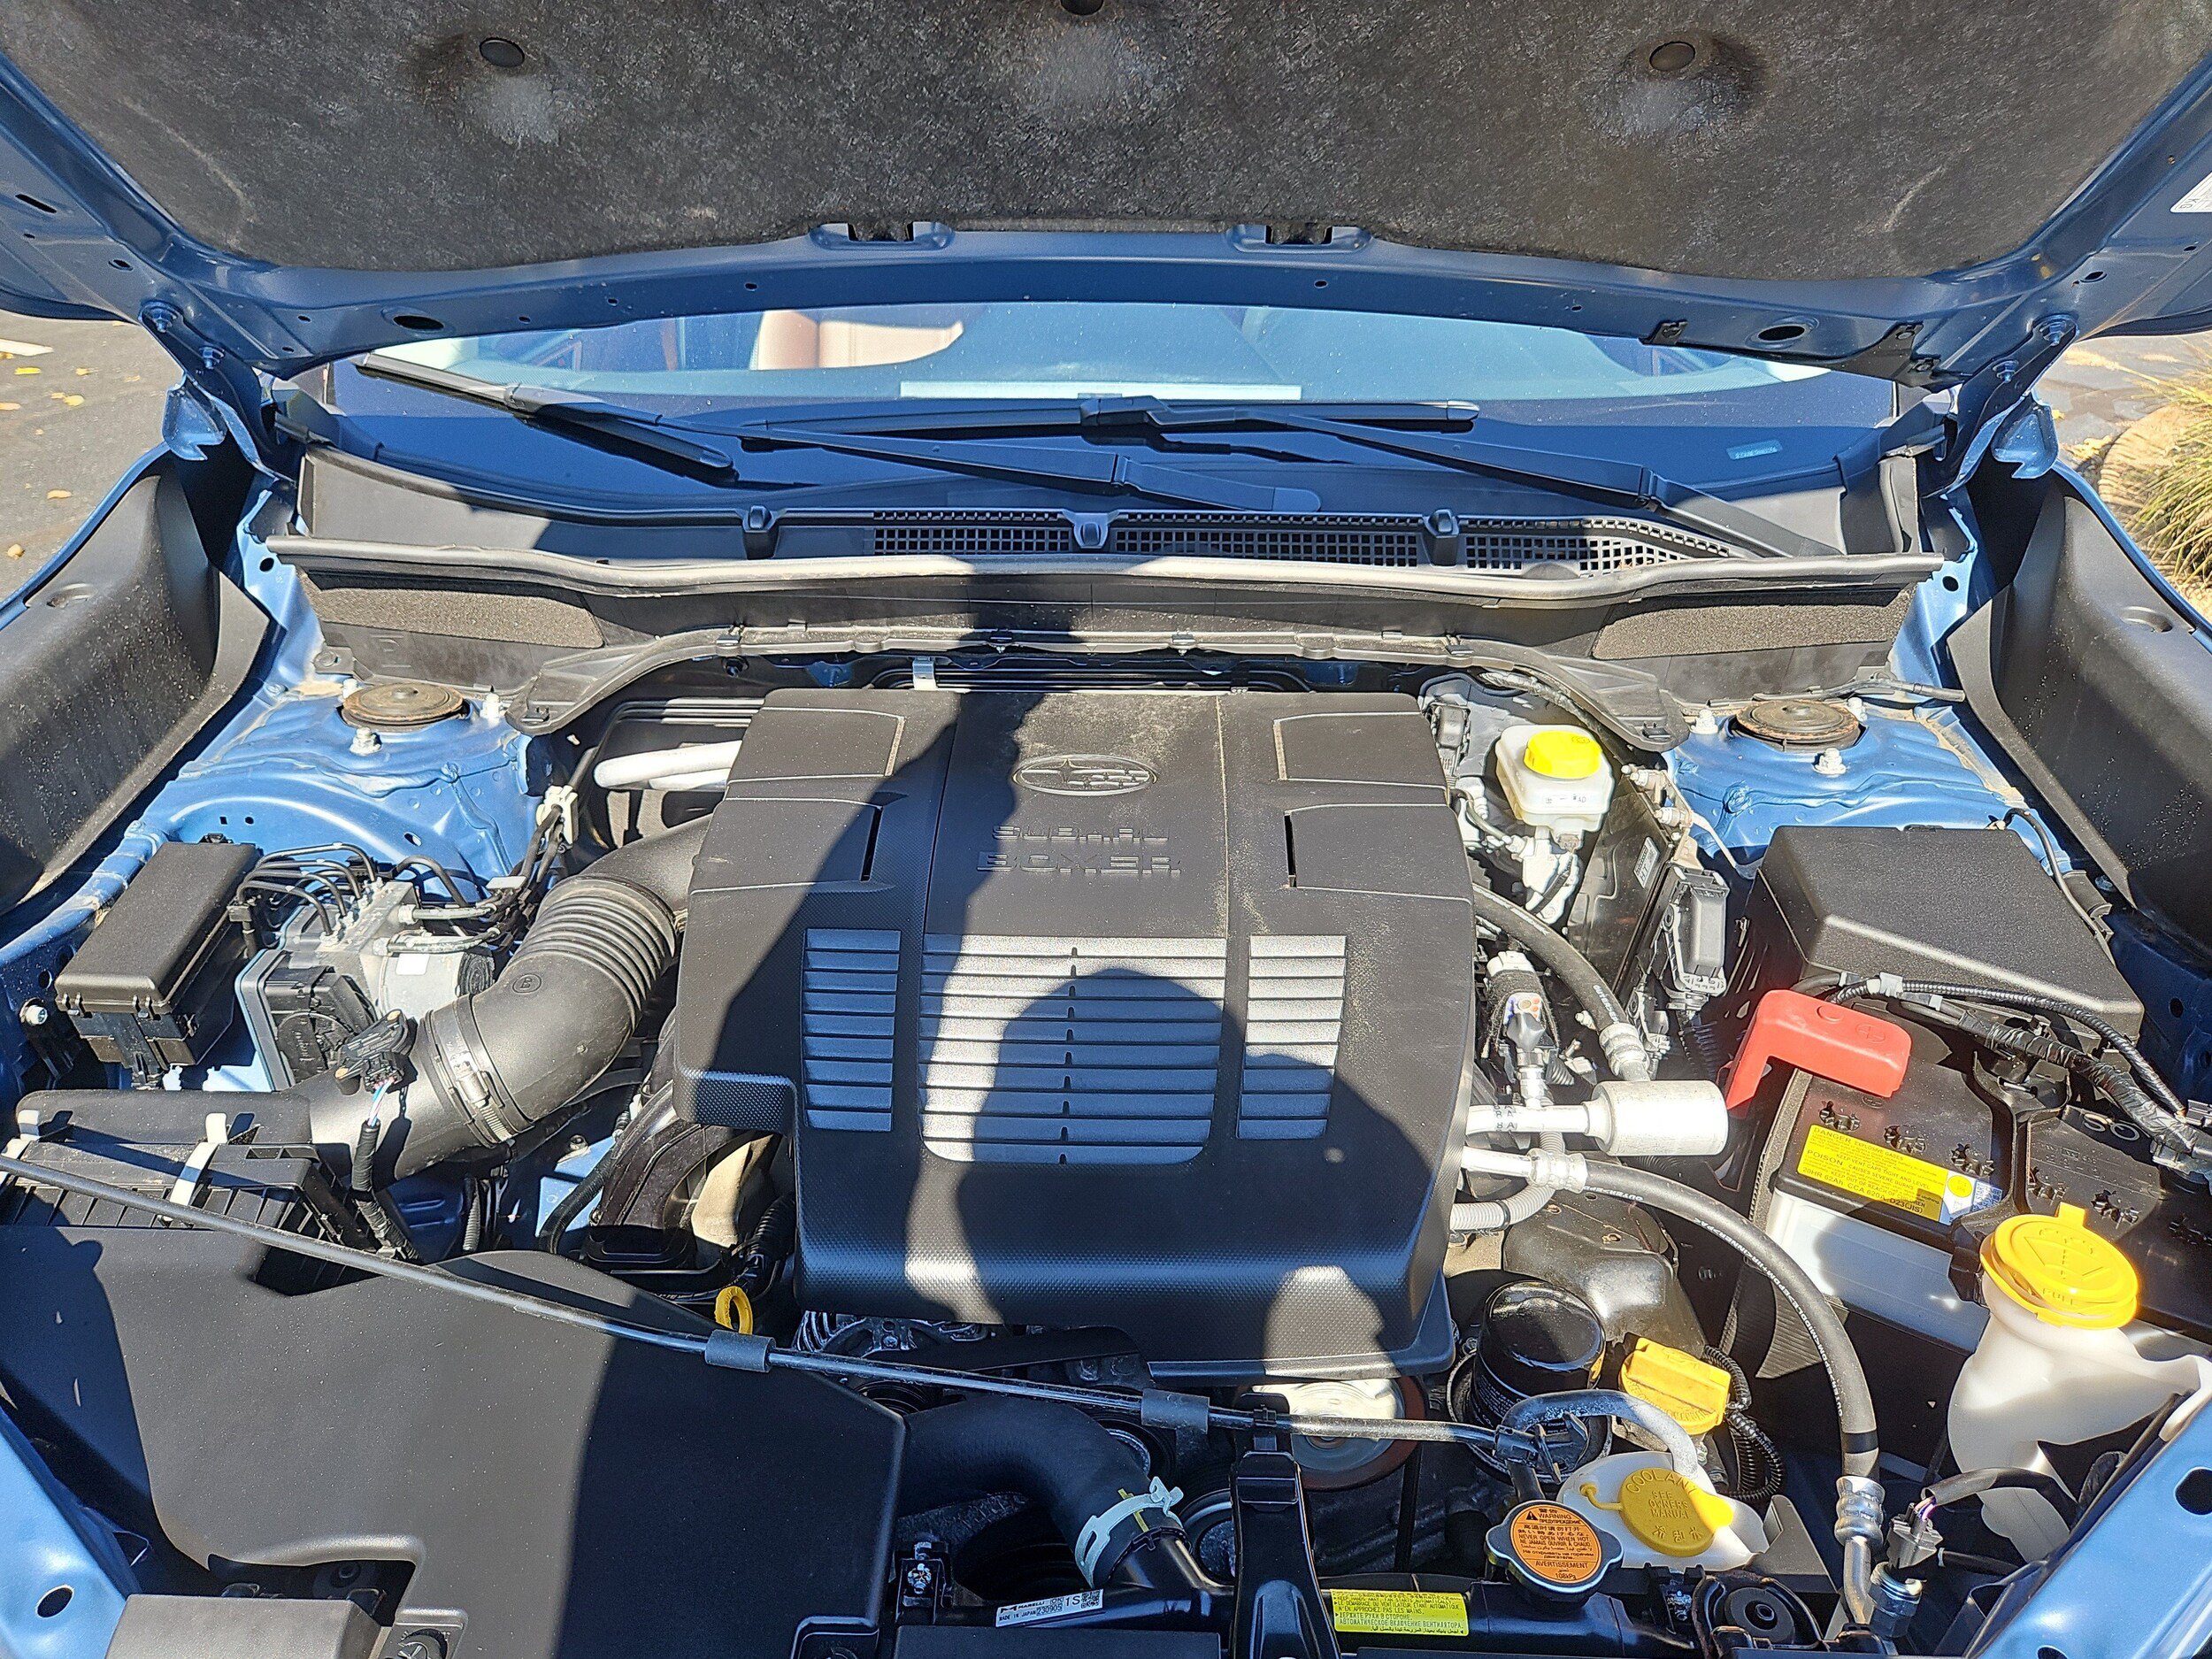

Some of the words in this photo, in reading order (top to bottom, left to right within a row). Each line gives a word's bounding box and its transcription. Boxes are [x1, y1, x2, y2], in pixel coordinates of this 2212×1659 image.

[992, 825, 1170, 843] SUBARU
[976, 850, 1182, 875] BOXER
[1813, 1127, 1851, 1143] DANGER
[1806, 1149, 1843, 1165] POISON
[1847, 1182, 1864, 1192] CCA
[1888, 1197, 1924, 1214] D23(JIS)
[1018, 1601, 1045, 1609] MARELLI
[1037, 1604, 1062, 1615] 230905
